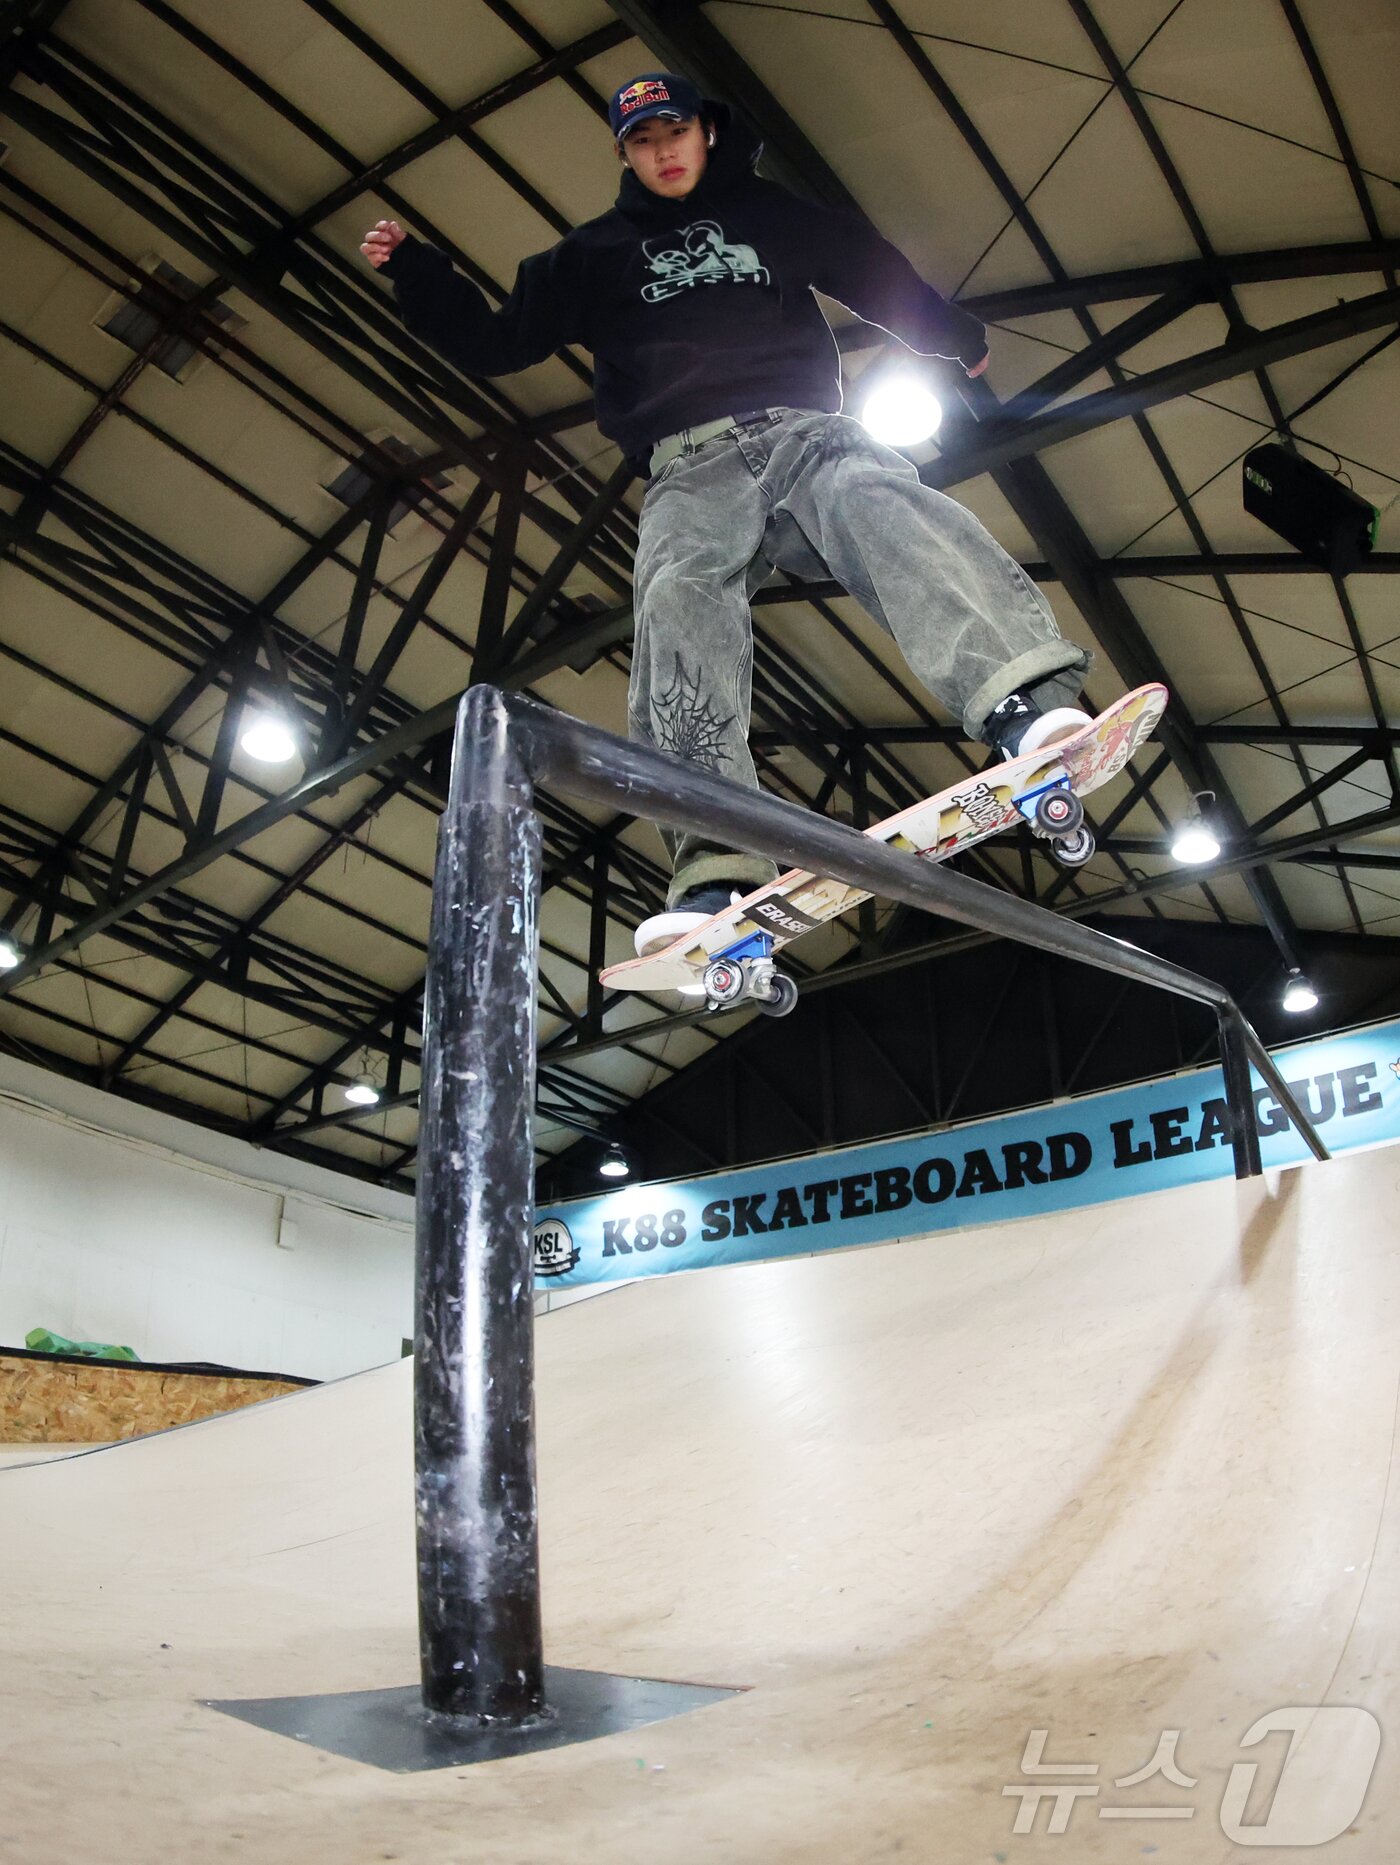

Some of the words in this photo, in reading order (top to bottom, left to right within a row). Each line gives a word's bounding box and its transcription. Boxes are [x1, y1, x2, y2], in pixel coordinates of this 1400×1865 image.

[602, 1208, 687, 1258] K88
[701, 1131, 1093, 1242] SKATEBOARD
[1110, 1061, 1383, 1169] LEAGUE
[534, 1232, 573, 1255] KSL
